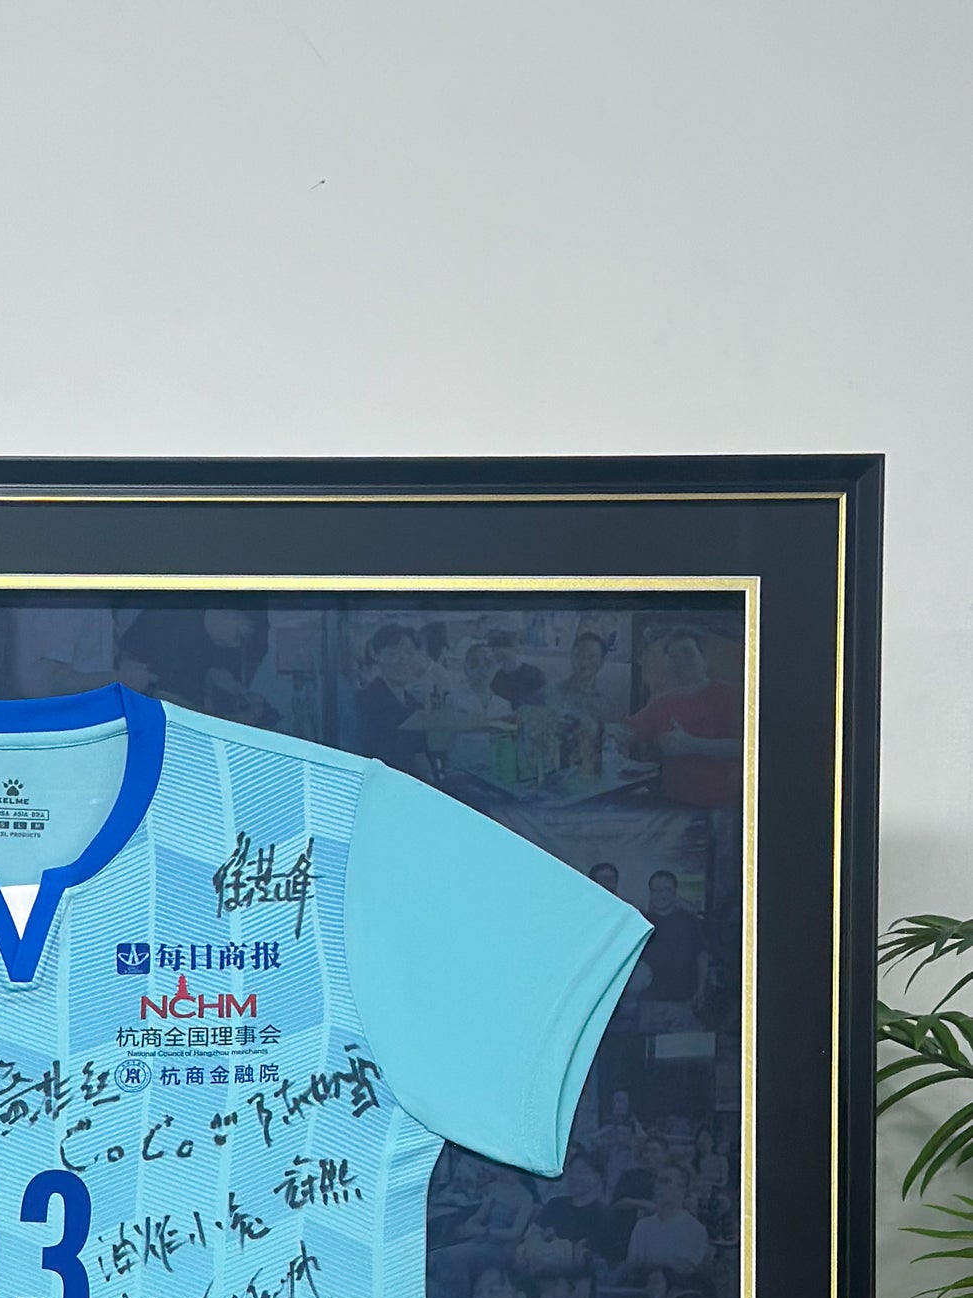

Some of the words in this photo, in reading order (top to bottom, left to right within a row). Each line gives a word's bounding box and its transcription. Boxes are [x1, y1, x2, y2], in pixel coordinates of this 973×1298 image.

[31, 811, 45, 819] BRA
[155, 941, 282, 971] 每日商报
[139, 993, 258, 1020] NCHM
[116, 1023, 282, 1048] 杭商全国理事会
[127, 1050, 156, 1058] National
[157, 1050, 184, 1058] Council
[193, 1050, 229, 1058] Hangzhou
[159, 1062, 280, 1086] 杭商金融院
